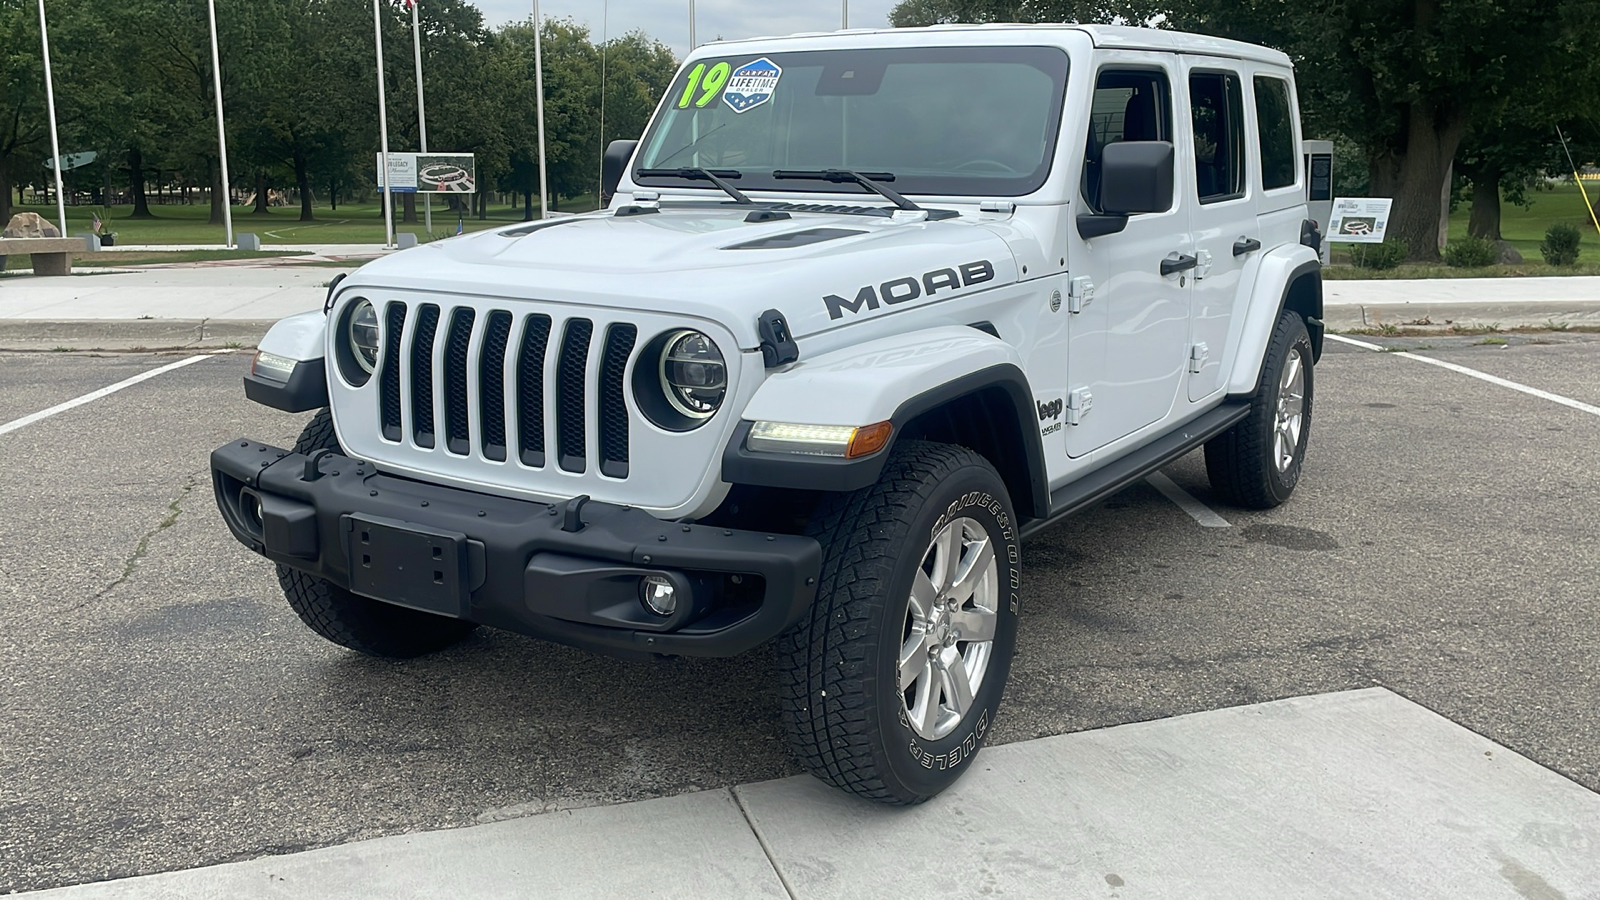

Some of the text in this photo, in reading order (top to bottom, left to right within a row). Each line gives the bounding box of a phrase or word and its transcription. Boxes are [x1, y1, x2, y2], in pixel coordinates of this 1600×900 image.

[678, 62, 732, 108] 19
[730, 77, 776, 88] LIFETIME
[822, 259, 995, 320] MOAB
[930, 491, 1019, 616] BRIDGESTONE
[909, 708, 989, 770] DUELER
